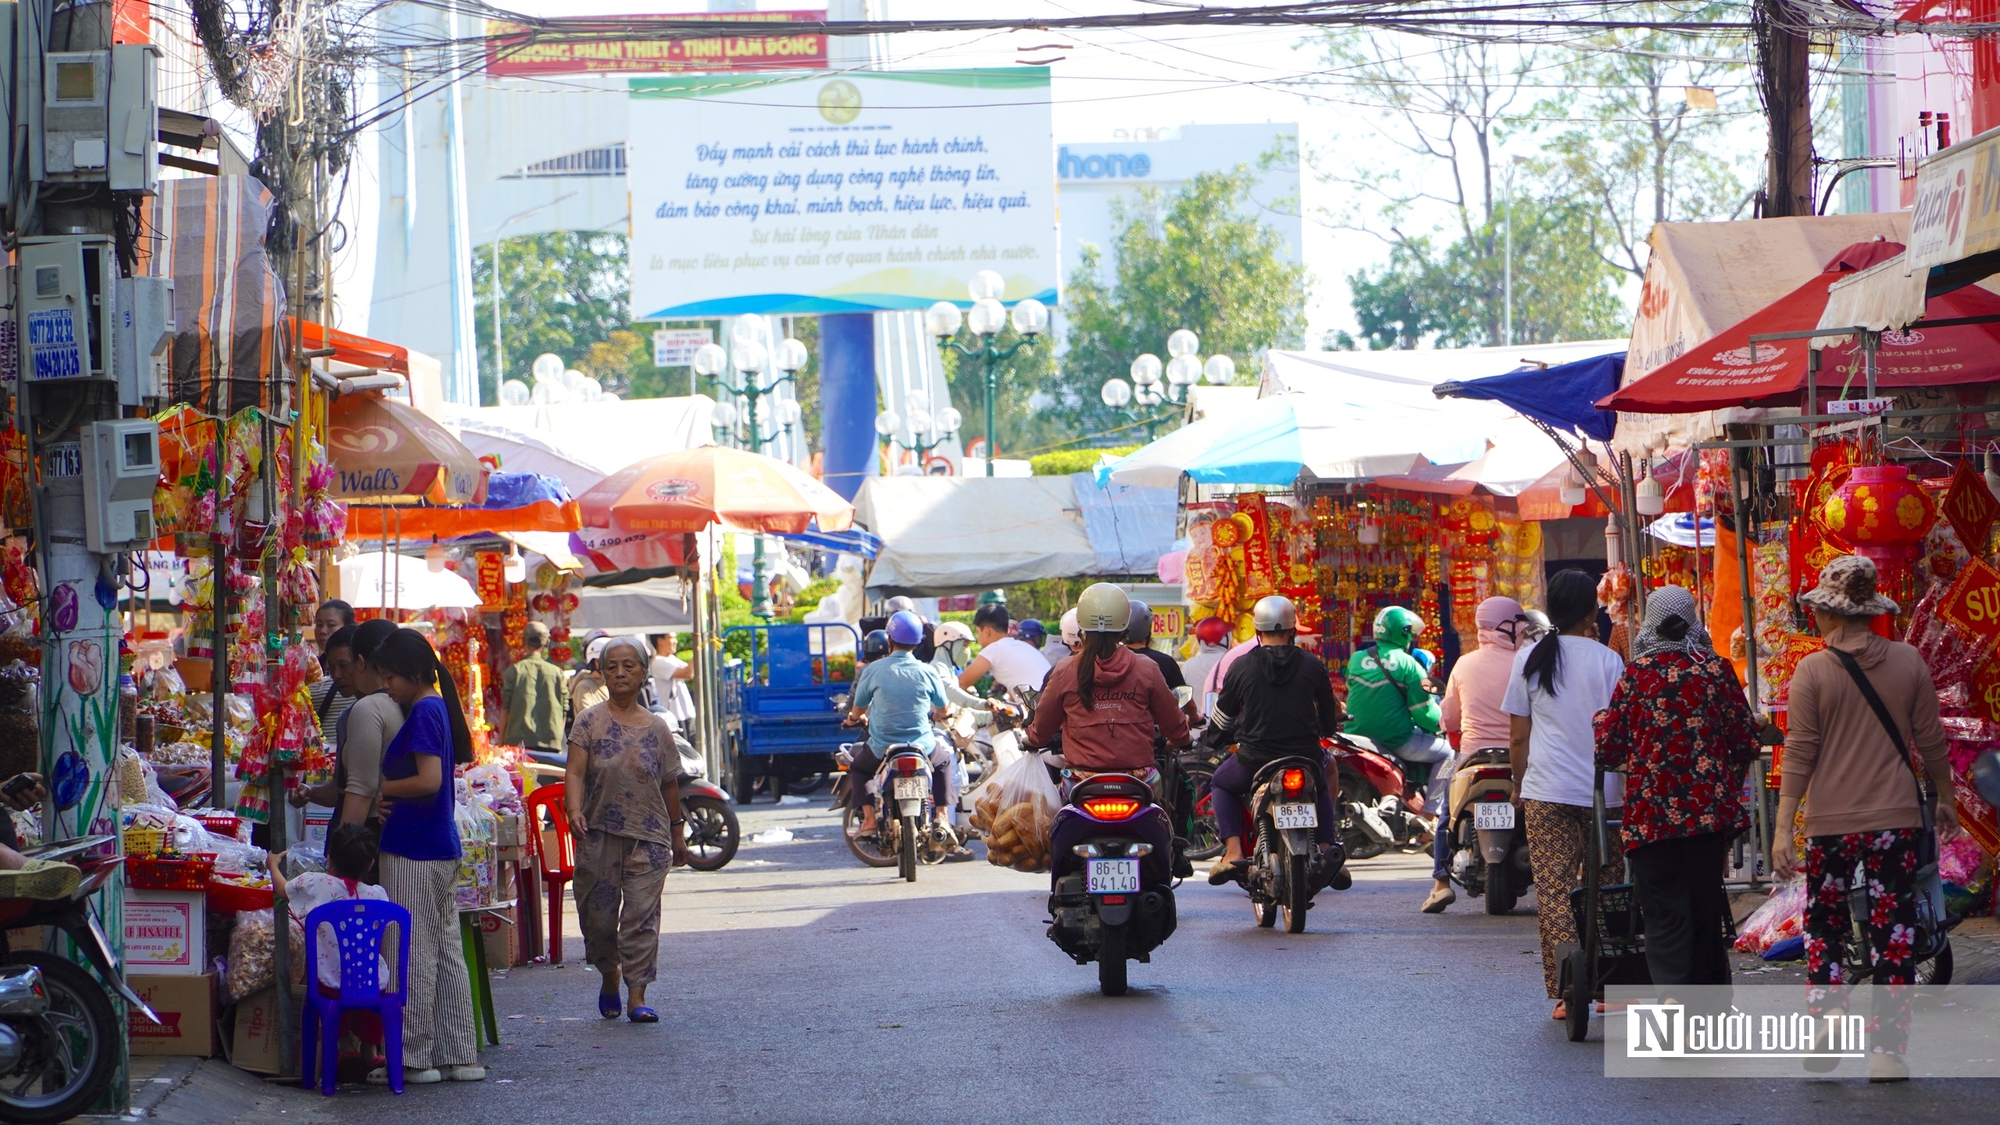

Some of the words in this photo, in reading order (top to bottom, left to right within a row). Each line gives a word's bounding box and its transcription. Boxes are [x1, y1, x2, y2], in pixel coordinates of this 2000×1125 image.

[574, 41, 621, 60] PHAN
[696, 141, 727, 167] Đẩy
[732, 142, 774, 163] mạnh
[778, 141, 802, 158] cải
[805, 139, 840, 157] cách
[845, 138, 869, 156] thủ
[874, 138, 897, 159] tục
[901, 137, 939, 155] hành
[1058, 146, 1151, 179] hone
[685, 172, 719, 195] tăng
[723, 171, 768, 194] cường
[773, 170, 801, 193] ứng
[806, 168, 844, 191] dụng
[848, 168, 884, 191] công
[888, 166, 925, 190] nghệ
[929, 164, 971, 188] thông
[655, 201, 688, 219] đảm
[693, 200, 721, 218] bảo
[725, 199, 760, 223] công
[806, 196, 843, 214] minh
[893, 194, 925, 215] hiệu
[962, 192, 994, 213] hiệu
[773, 227, 797, 244] hài
[800, 226, 831, 249] lòng
[835, 226, 862, 243] của
[867, 224, 906, 241] Nhân
[911, 224, 939, 240] dân
[668, 256, 699, 274] mục
[703, 254, 730, 270] tiêu
[733, 252, 769, 273] phục
[795, 249, 821, 266] của
[846, 251, 882, 268] quan
[886, 247, 922, 264] hành
[926, 246, 964, 262] chính
[969, 245, 997, 261] nhà
[1906, 348, 1922, 357] PHÊ
[1924, 347, 1934, 356] LÊ
[339, 468, 399, 493] Wall's
[1280, 805, 1309, 816] 86-B4
[1481, 805, 1508, 816] 86-C1
[1278, 816, 1315, 827] 512.23
[1478, 816, 1512, 828] 861.37
[1096, 861, 1131, 875] 86-C1
[1091, 876, 1137, 890] 941.40
[136, 925, 183, 939] THANH
[132, 1025, 174, 1034] PRUNES
[247, 1006, 265, 1039] Tipo
